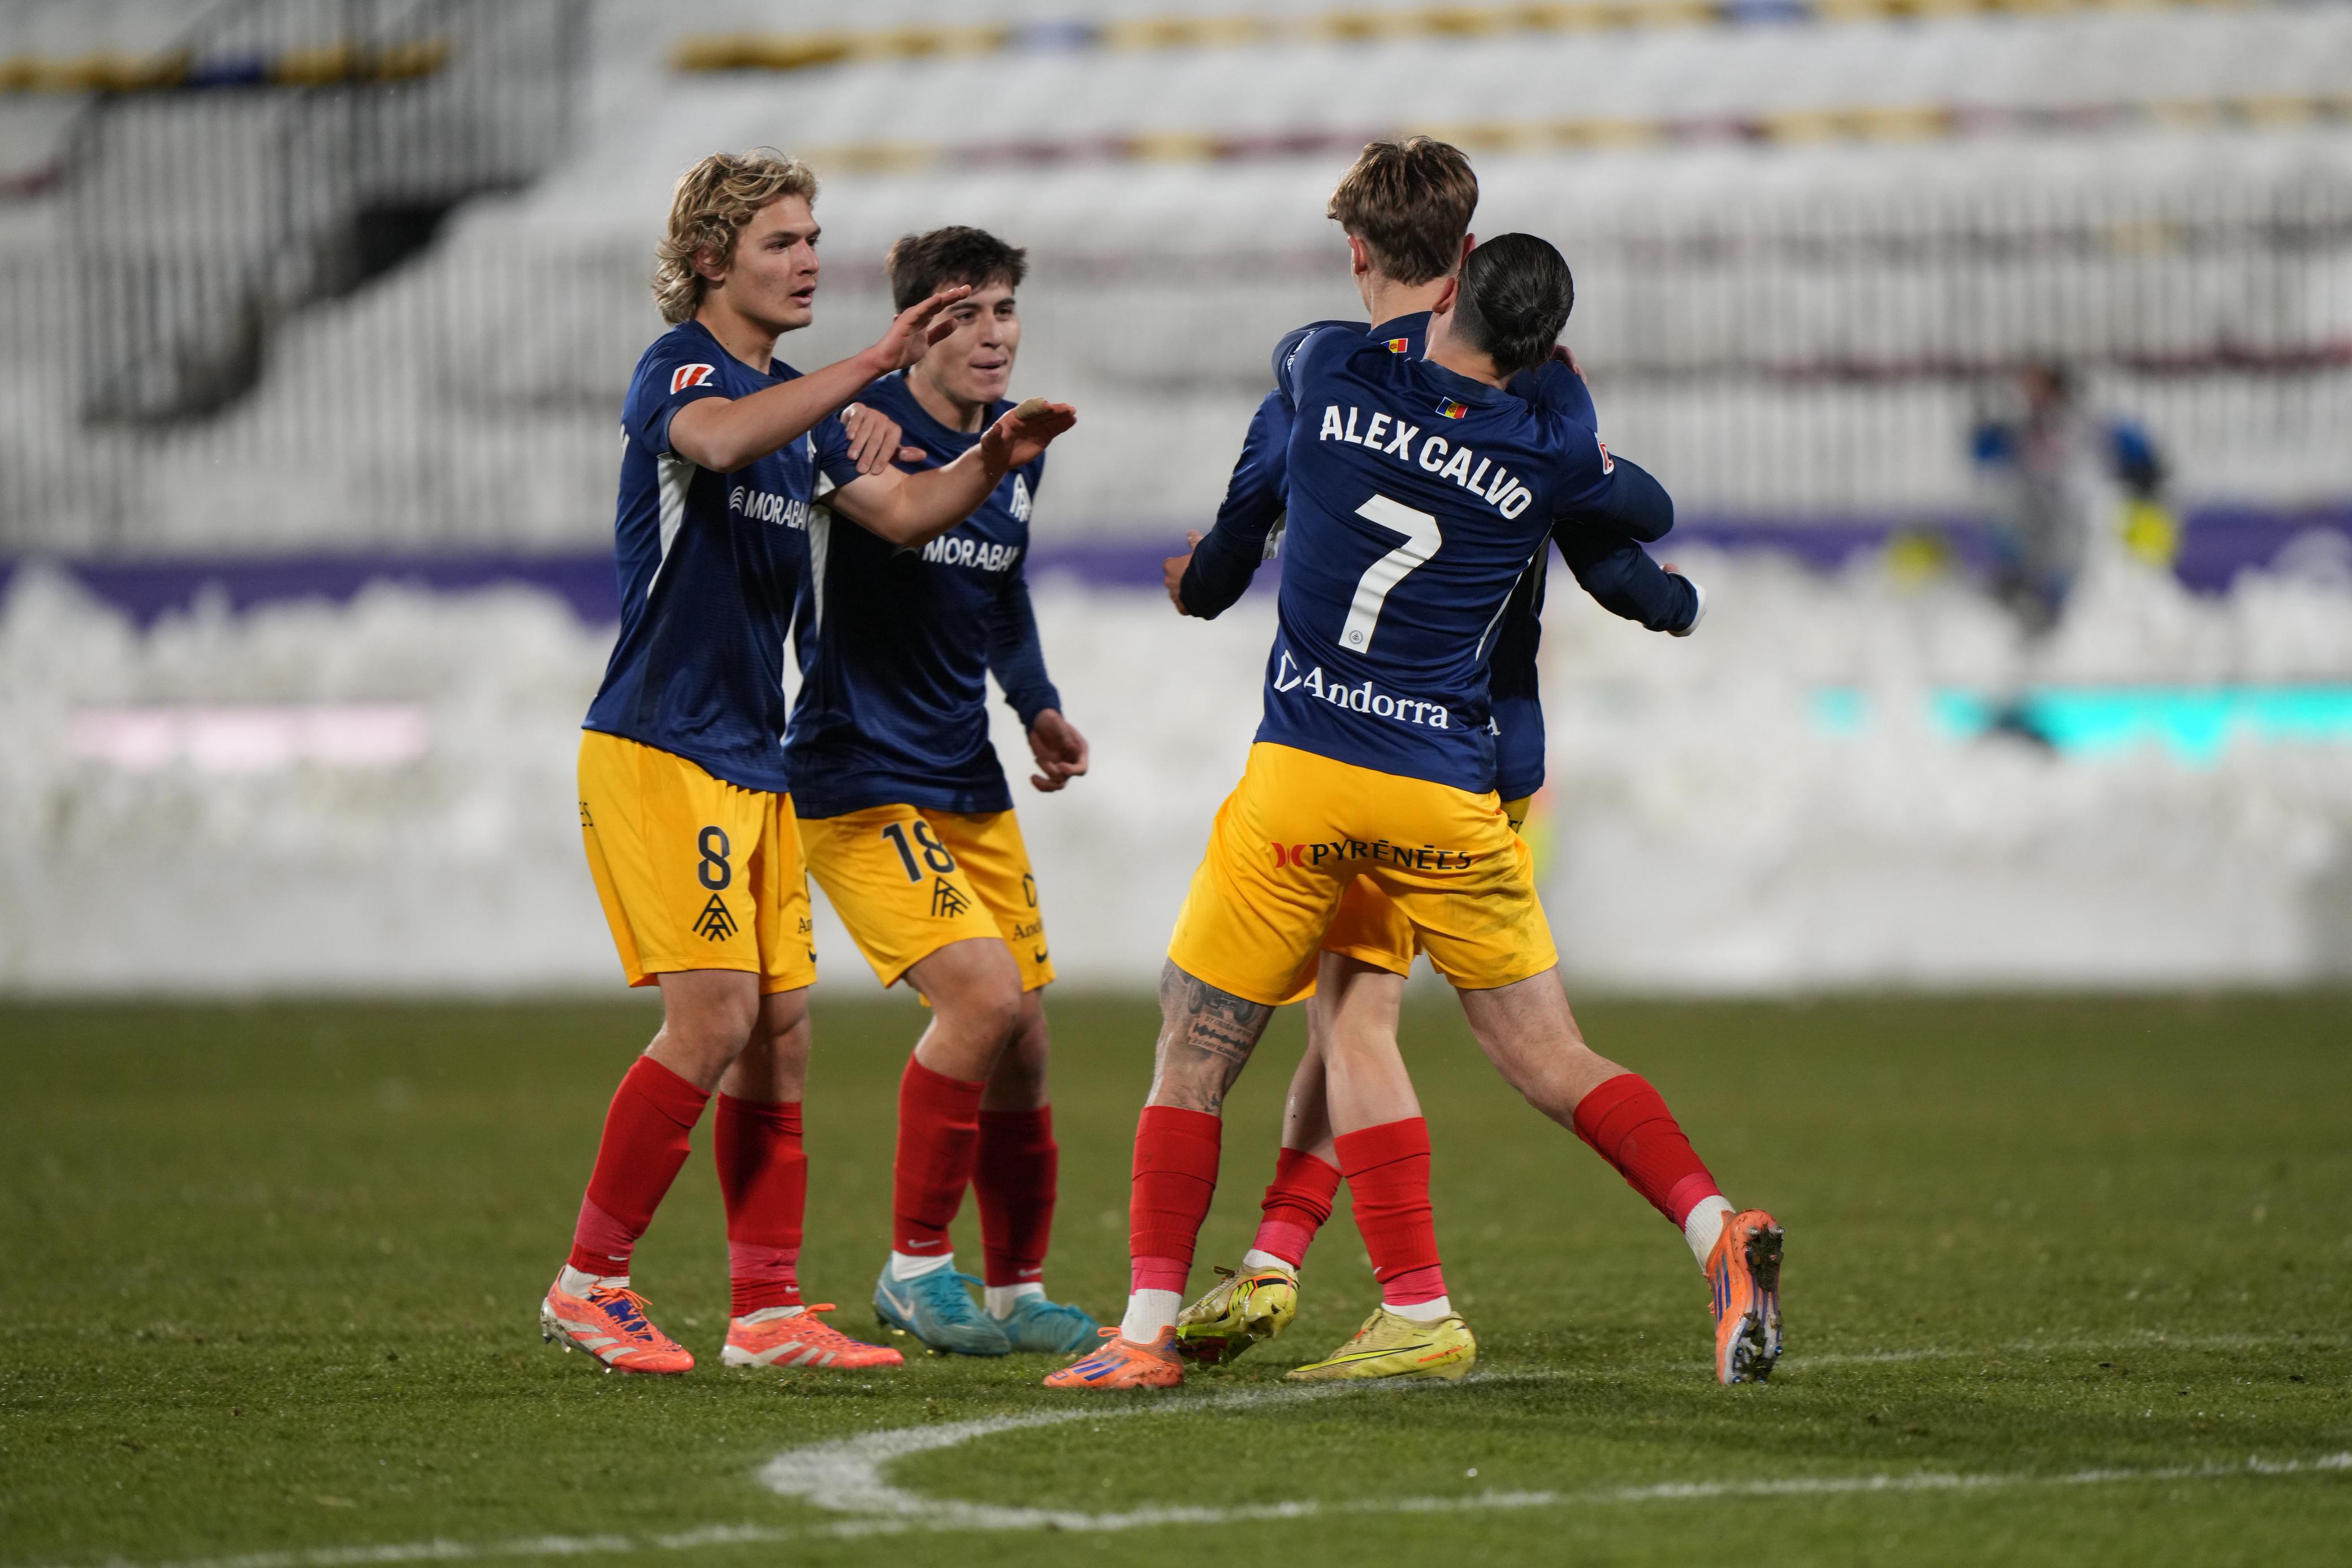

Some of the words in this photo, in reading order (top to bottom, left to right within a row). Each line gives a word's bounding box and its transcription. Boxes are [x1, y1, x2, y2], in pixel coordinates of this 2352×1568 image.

[1320, 405, 1420, 461] ALEX
[1419, 435, 1532, 519] CALVO
[743, 490, 810, 531] MORABA
[922, 535, 1021, 572] MORABA
[1338, 493, 1442, 654] 7
[1303, 667, 1449, 729] Andorra
[698, 826, 730, 890] 8
[882, 820, 954, 882] 18
